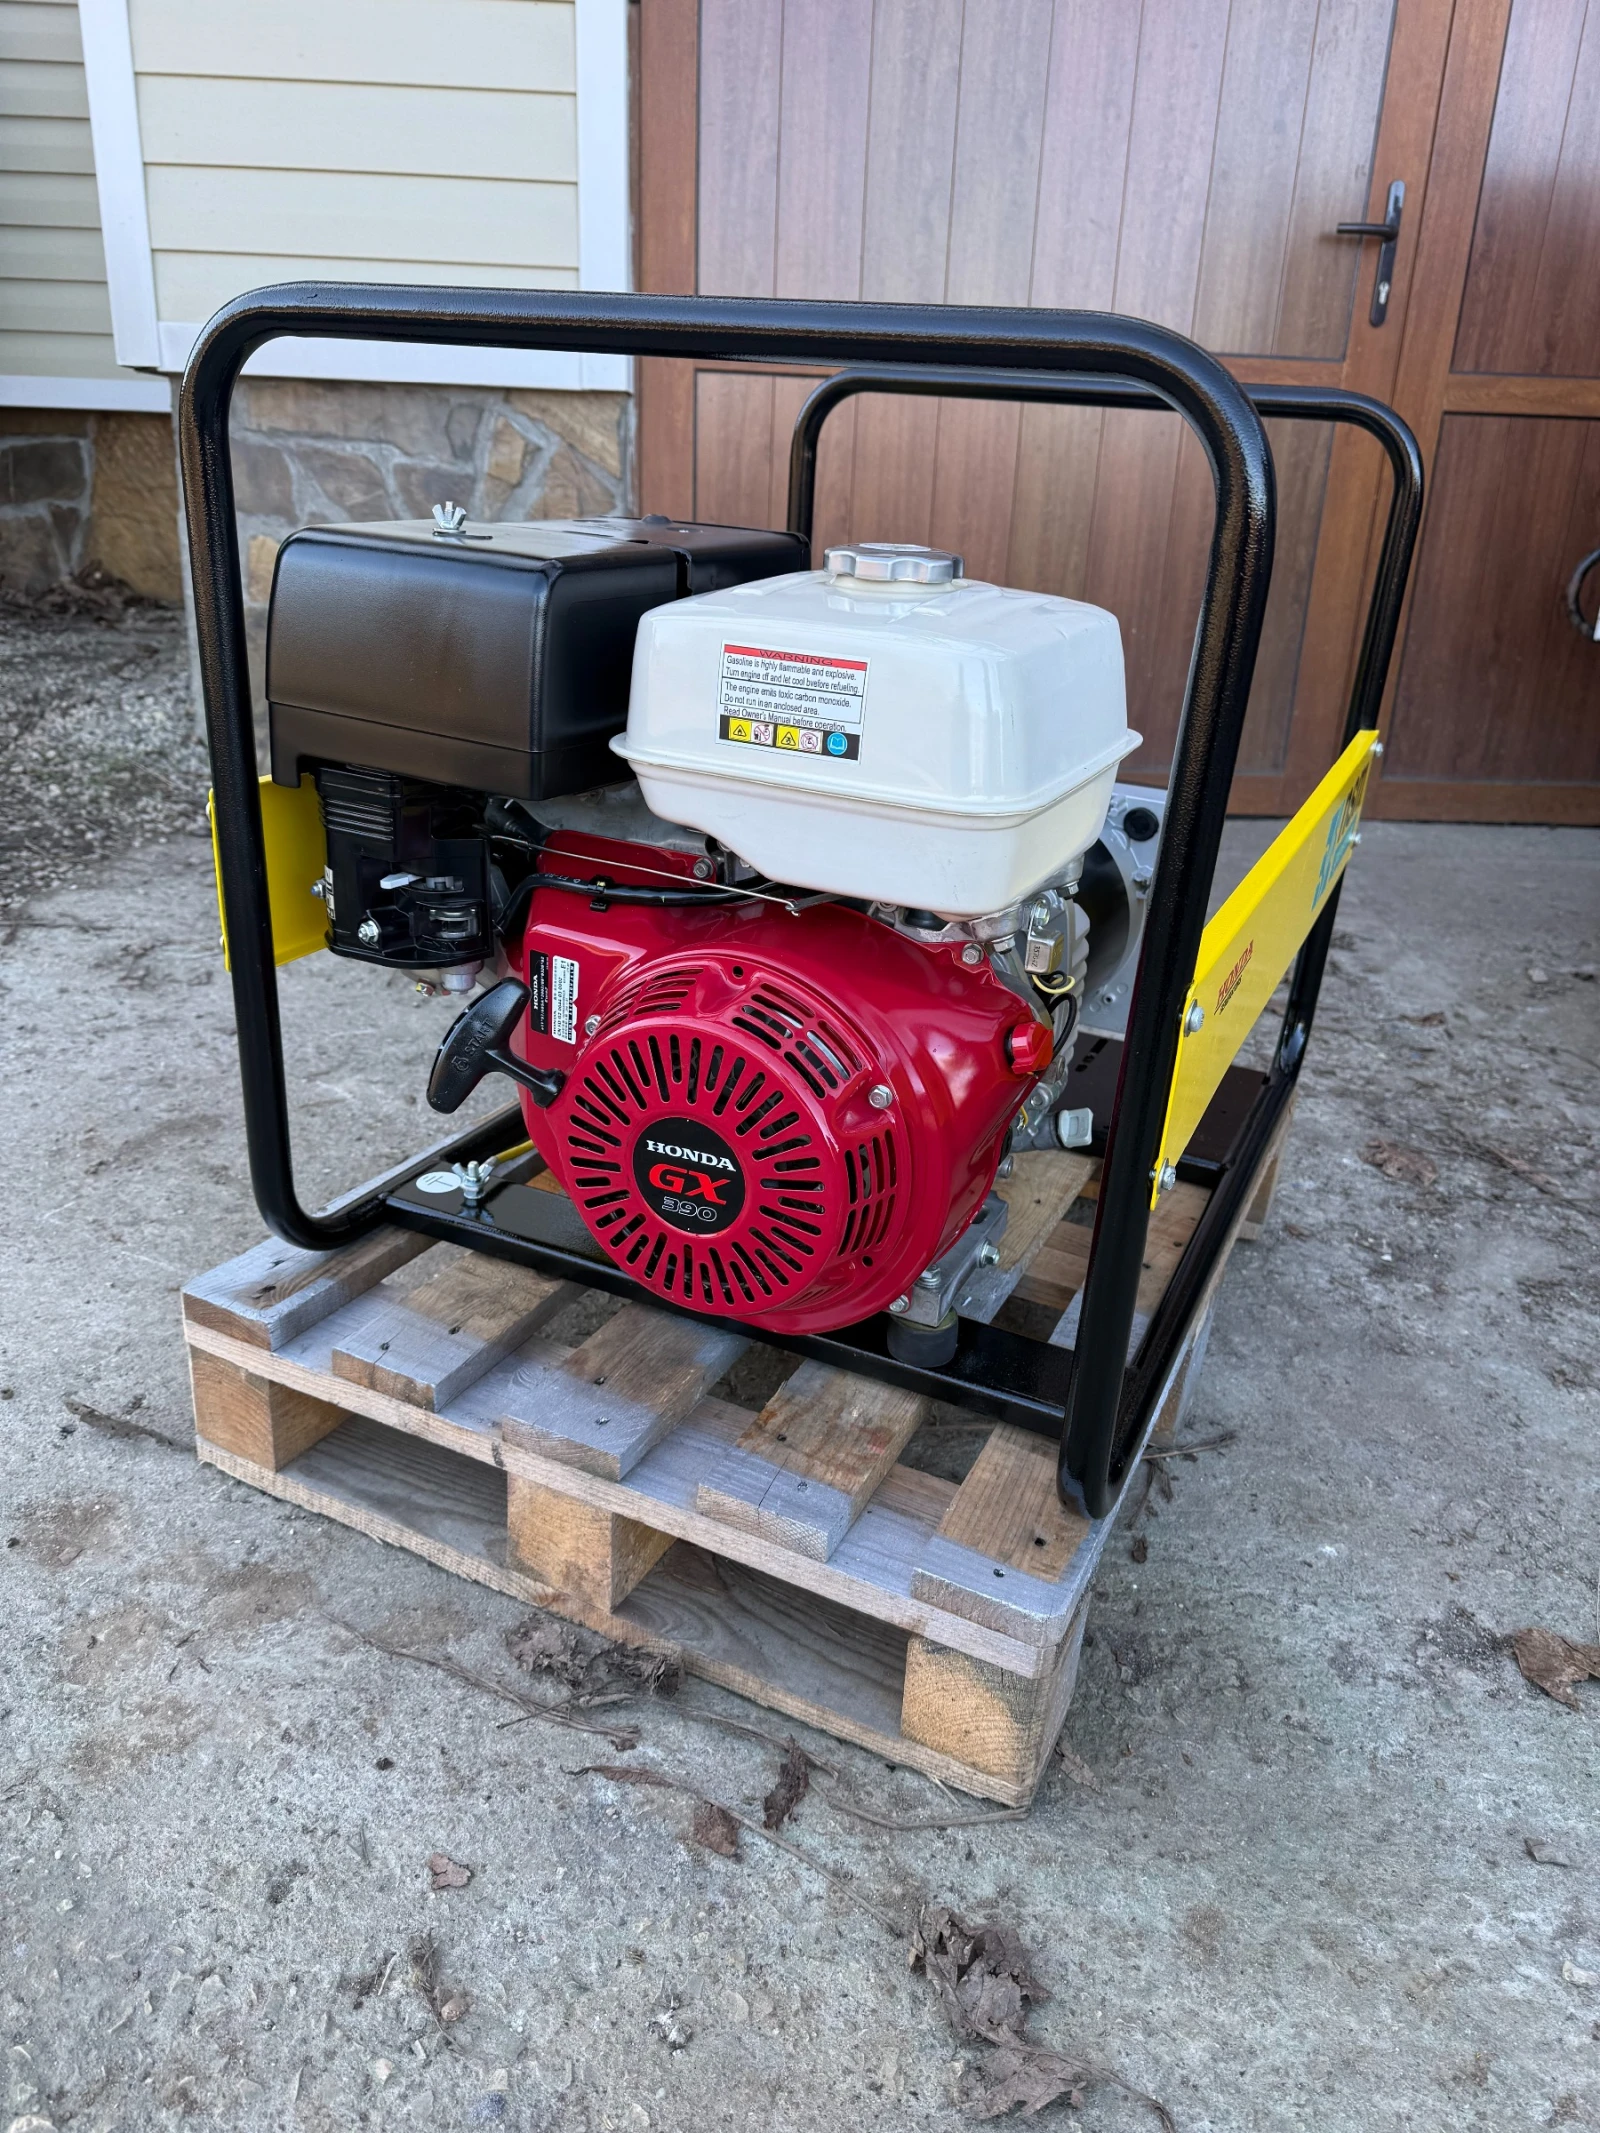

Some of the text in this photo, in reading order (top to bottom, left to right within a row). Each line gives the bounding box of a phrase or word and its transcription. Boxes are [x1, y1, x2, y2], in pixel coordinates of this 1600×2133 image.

[726, 655, 753, 667] Gasoline
[754, 659, 759, 668] is
[761, 660, 778, 672] highly
[812, 668, 824, 677] and
[825, 669, 857, 681] explosive.
[759, 650, 833, 666] WARNING
[725, 681, 852, 708] The engine emits toxic carbon monoxide.
[726, 667, 739, 677] Turn
[740, 671, 760, 681] engine
[770, 674, 781, 683] and
[783, 674, 791, 684] let
[792, 677, 805, 687] cool
[831, 683, 860, 695] refueling.
[724, 693, 733, 703] Do
[734, 696, 745, 705] not
[746, 698, 756, 707] run
[803, 706, 820, 716] area.
[723, 705, 847, 733] Read Owner's Manual before operation.
[465, 1018, 493, 1056] START
[646, 1140, 737, 1172] HONDA
[649, 1164, 731, 1205] GX
[661, 1196, 717, 1222] 390
